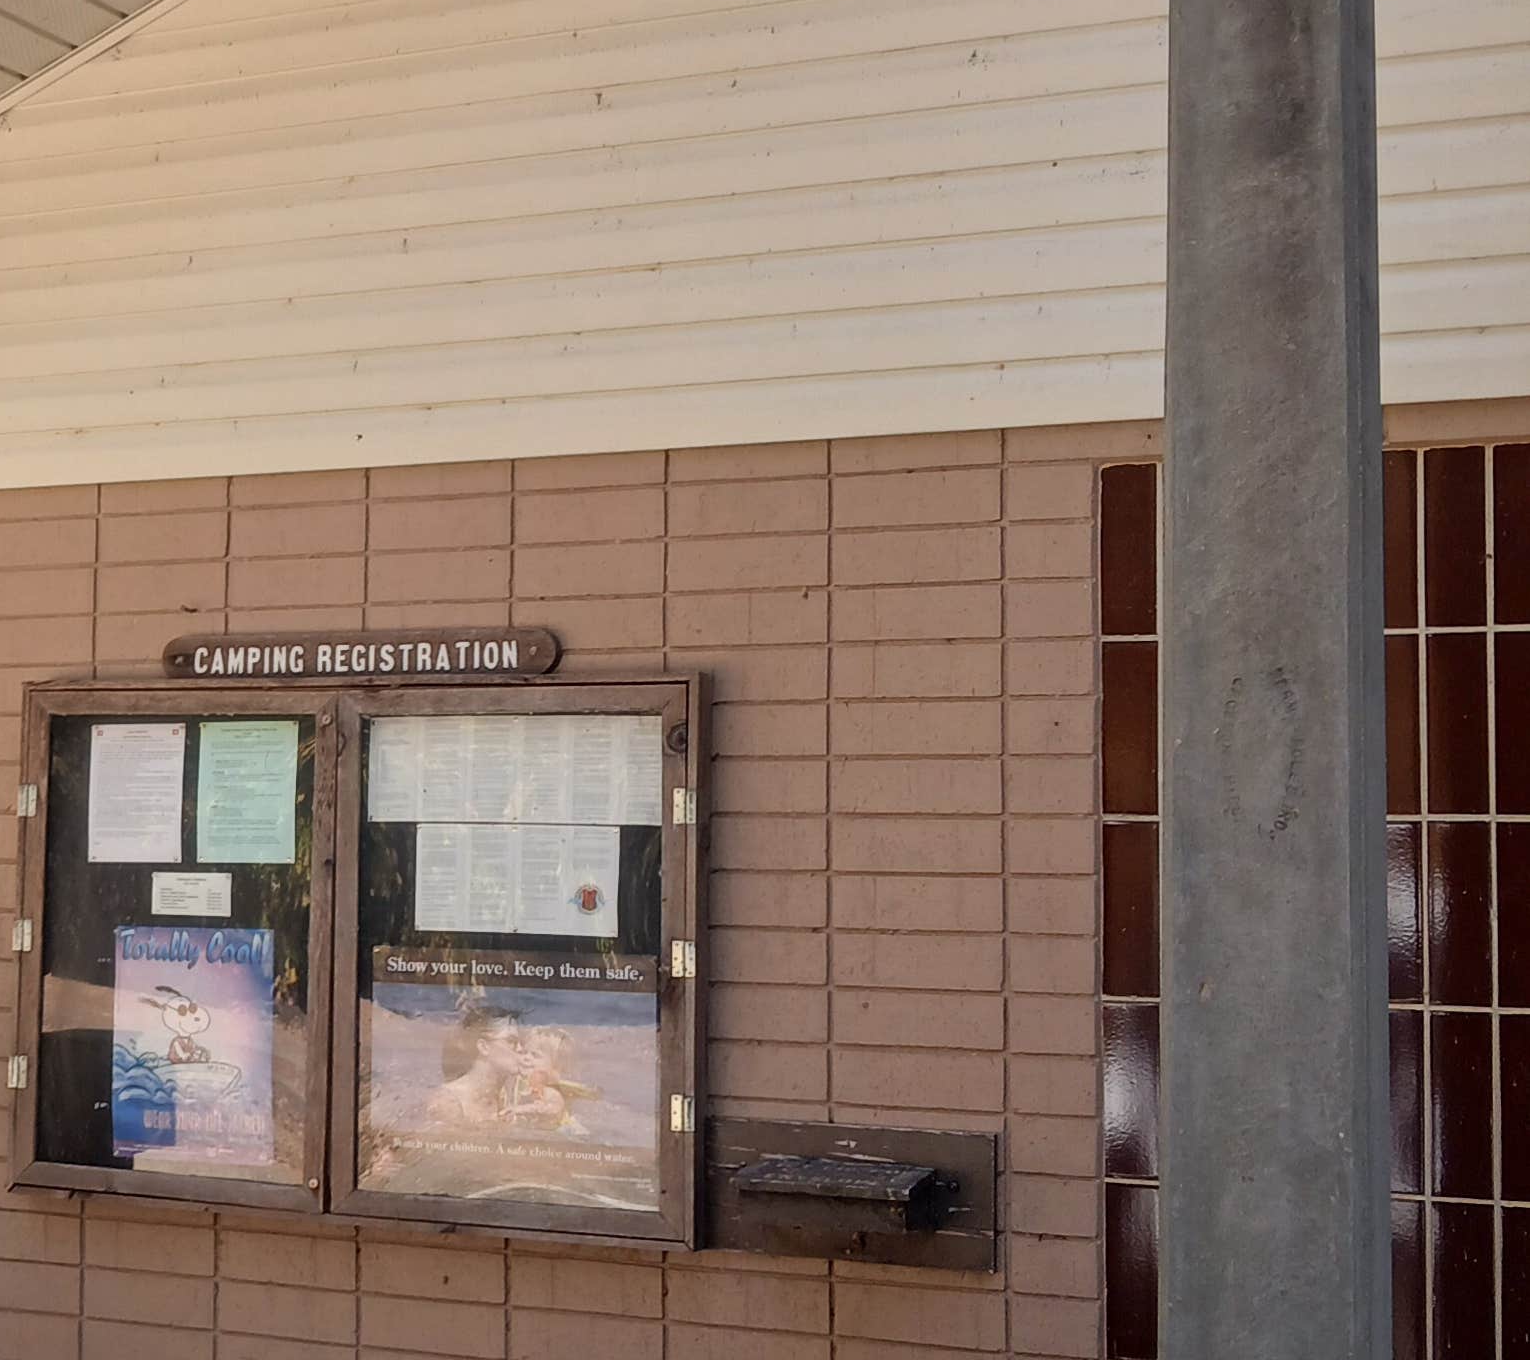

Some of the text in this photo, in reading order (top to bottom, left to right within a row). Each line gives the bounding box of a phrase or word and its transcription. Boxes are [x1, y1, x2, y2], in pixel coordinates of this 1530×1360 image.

[193, 639, 520, 675] CAMPING REGISTRATION
[120, 928, 201, 970] Totally
[386, 956, 645, 982] Show your love. Keep them safe.
[424, 1140, 448, 1155] your
[450, 1141, 491, 1153] children.
[496, 1143, 505, 1155] A
[565, 1150, 602, 1161] around
